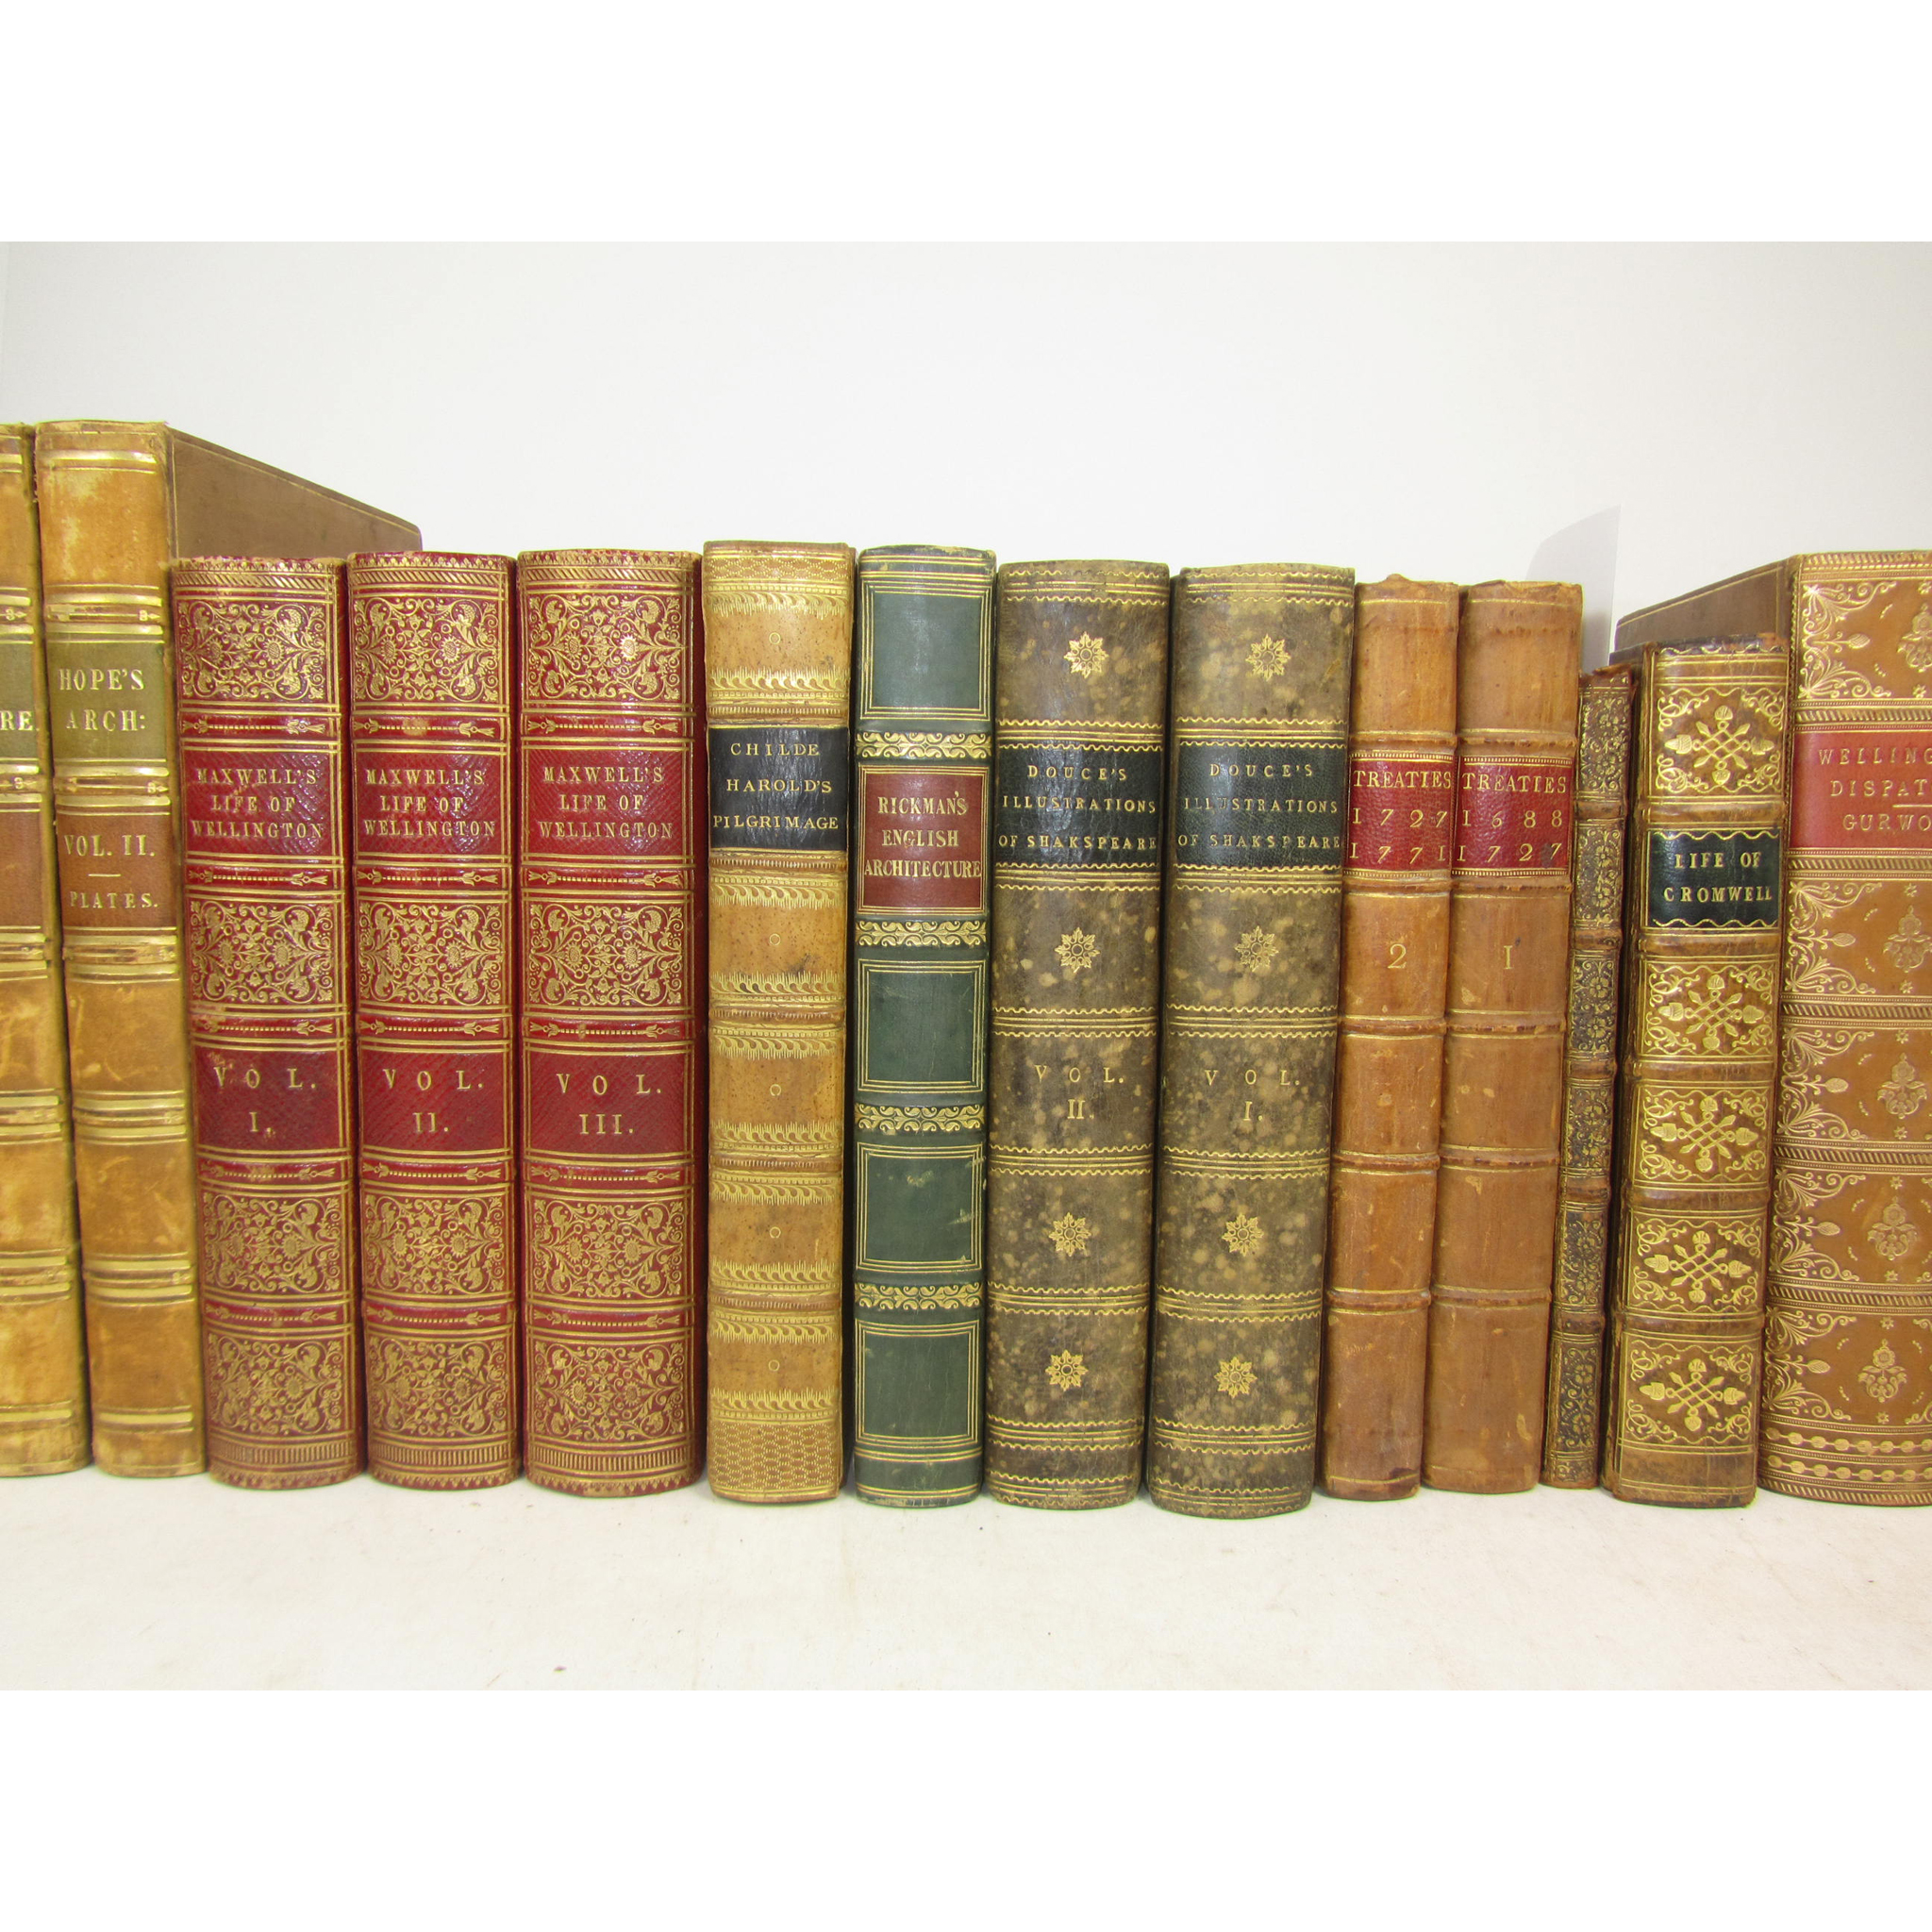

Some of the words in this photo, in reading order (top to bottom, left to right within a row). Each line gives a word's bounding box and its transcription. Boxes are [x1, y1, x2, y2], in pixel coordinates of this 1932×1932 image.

[58, 668, 144, 691] HOPE'S
[66, 709, 145, 732] ARCH:
[730, 742, 820, 757] CHILDE
[196, 769, 317, 784] MAXWELL'S
[365, 769, 485, 785] MAXWELL'S
[543, 766, 664, 783] MAXWELL'S
[1027, 765, 1128, 781] DOUCE'S
[1209, 763, 1313, 777] DOUCE'S
[1353, 770, 1452, 789] TREATIES
[726, 778, 833, 793] HAROLD'S
[1461, 772, 1567, 793] TREATIES
[210, 795, 258, 812] LIFE
[270, 796, 296, 812] OF
[380, 795, 426, 812] LIFE
[439, 796, 465, 813] OF
[559, 794, 608, 811] LIFE
[619, 794, 644, 811] OF
[877, 791, 968, 816] RICKMAN'S
[1003, 795, 1156, 814] ILLUSTRATIONS
[1184, 797, 1338, 814] ILLUSTRATIONS
[713, 815, 839, 830] PILGRIMAGE
[1352, 808, 1448, 829] 1727
[1462, 808, 1563, 828] 1688
[192, 820, 323, 839] WELLINGTON
[364, 820, 496, 837] WELLINGTON
[539, 821, 674, 839] WELLINGTON
[64, 834, 112, 857] VOL.
[122, 834, 156, 857] II.
[882, 829, 958, 848] ENGLISH
[998, 835, 1018, 847] OF
[1026, 835, 1158, 851] SHAKSPEARE
[1177, 834, 1199, 847] OF
[1209, 834, 1341, 849] SHAKSPEARE
[1349, 842, 1446, 864] 1771
[1457, 842, 1562, 862] 1727
[1674, 852, 1724, 869] LIFE
[1740, 851, 1762, 868] OF
[864, 858, 982, 878] ARCHITECTURE
[70, 891, 158, 908] PLATES.
[1663, 886, 1773, 903] CROMWELL
[1387, 943, 1407, 969] 2
[213, 1066, 316, 1089] VOL.
[382, 1068, 483, 1091] VOL.
[1035, 1064, 1124, 1083] VOL.
[1204, 1069, 1300, 1086] VOL.
[556, 1073, 661, 1095] VOL.
[412, 1112, 449, 1132] II.
[579, 1114, 634, 1134] III.
